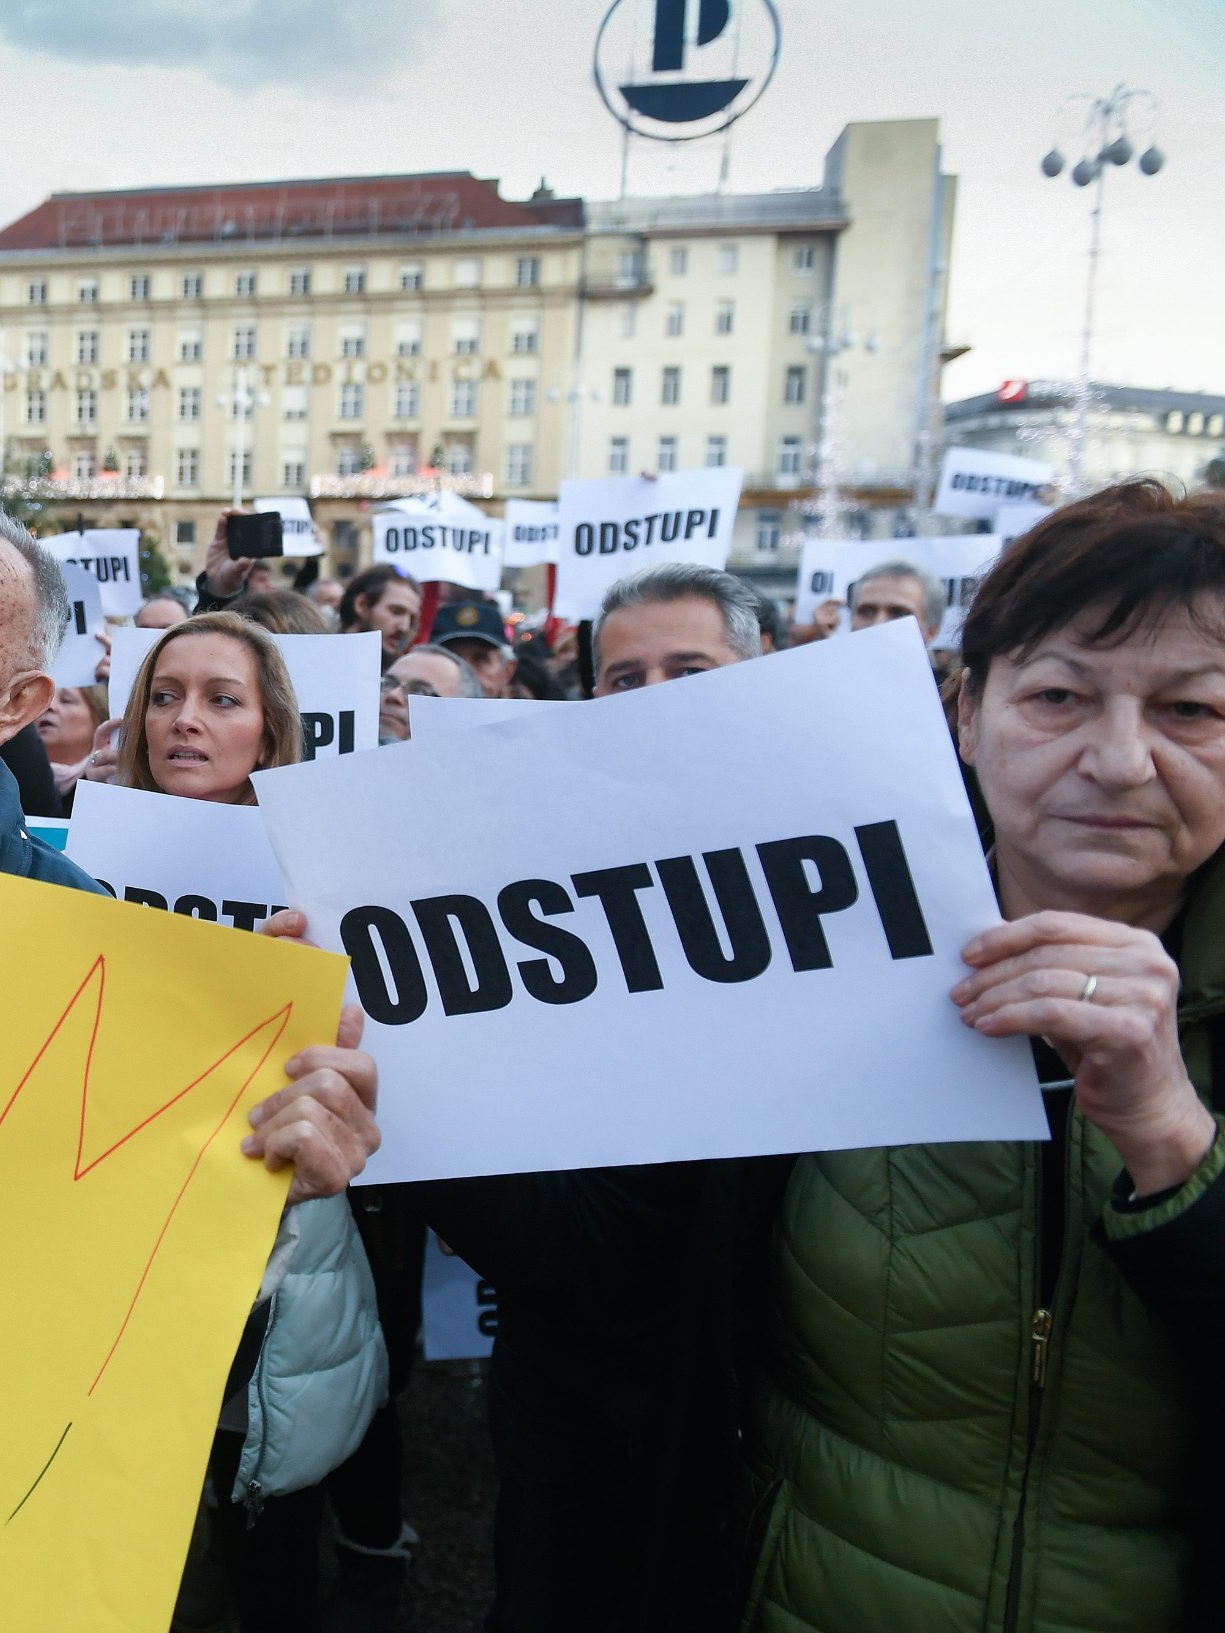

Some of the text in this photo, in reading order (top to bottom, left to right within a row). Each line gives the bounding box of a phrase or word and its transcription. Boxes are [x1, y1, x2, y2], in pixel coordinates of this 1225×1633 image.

[260, 358, 501, 387] TEDIONICA
[385, 526, 491, 555] ODSTUPI
[575, 508, 720, 557] ODSTUPI
[340, 818, 935, 1027] ODSTUPI
